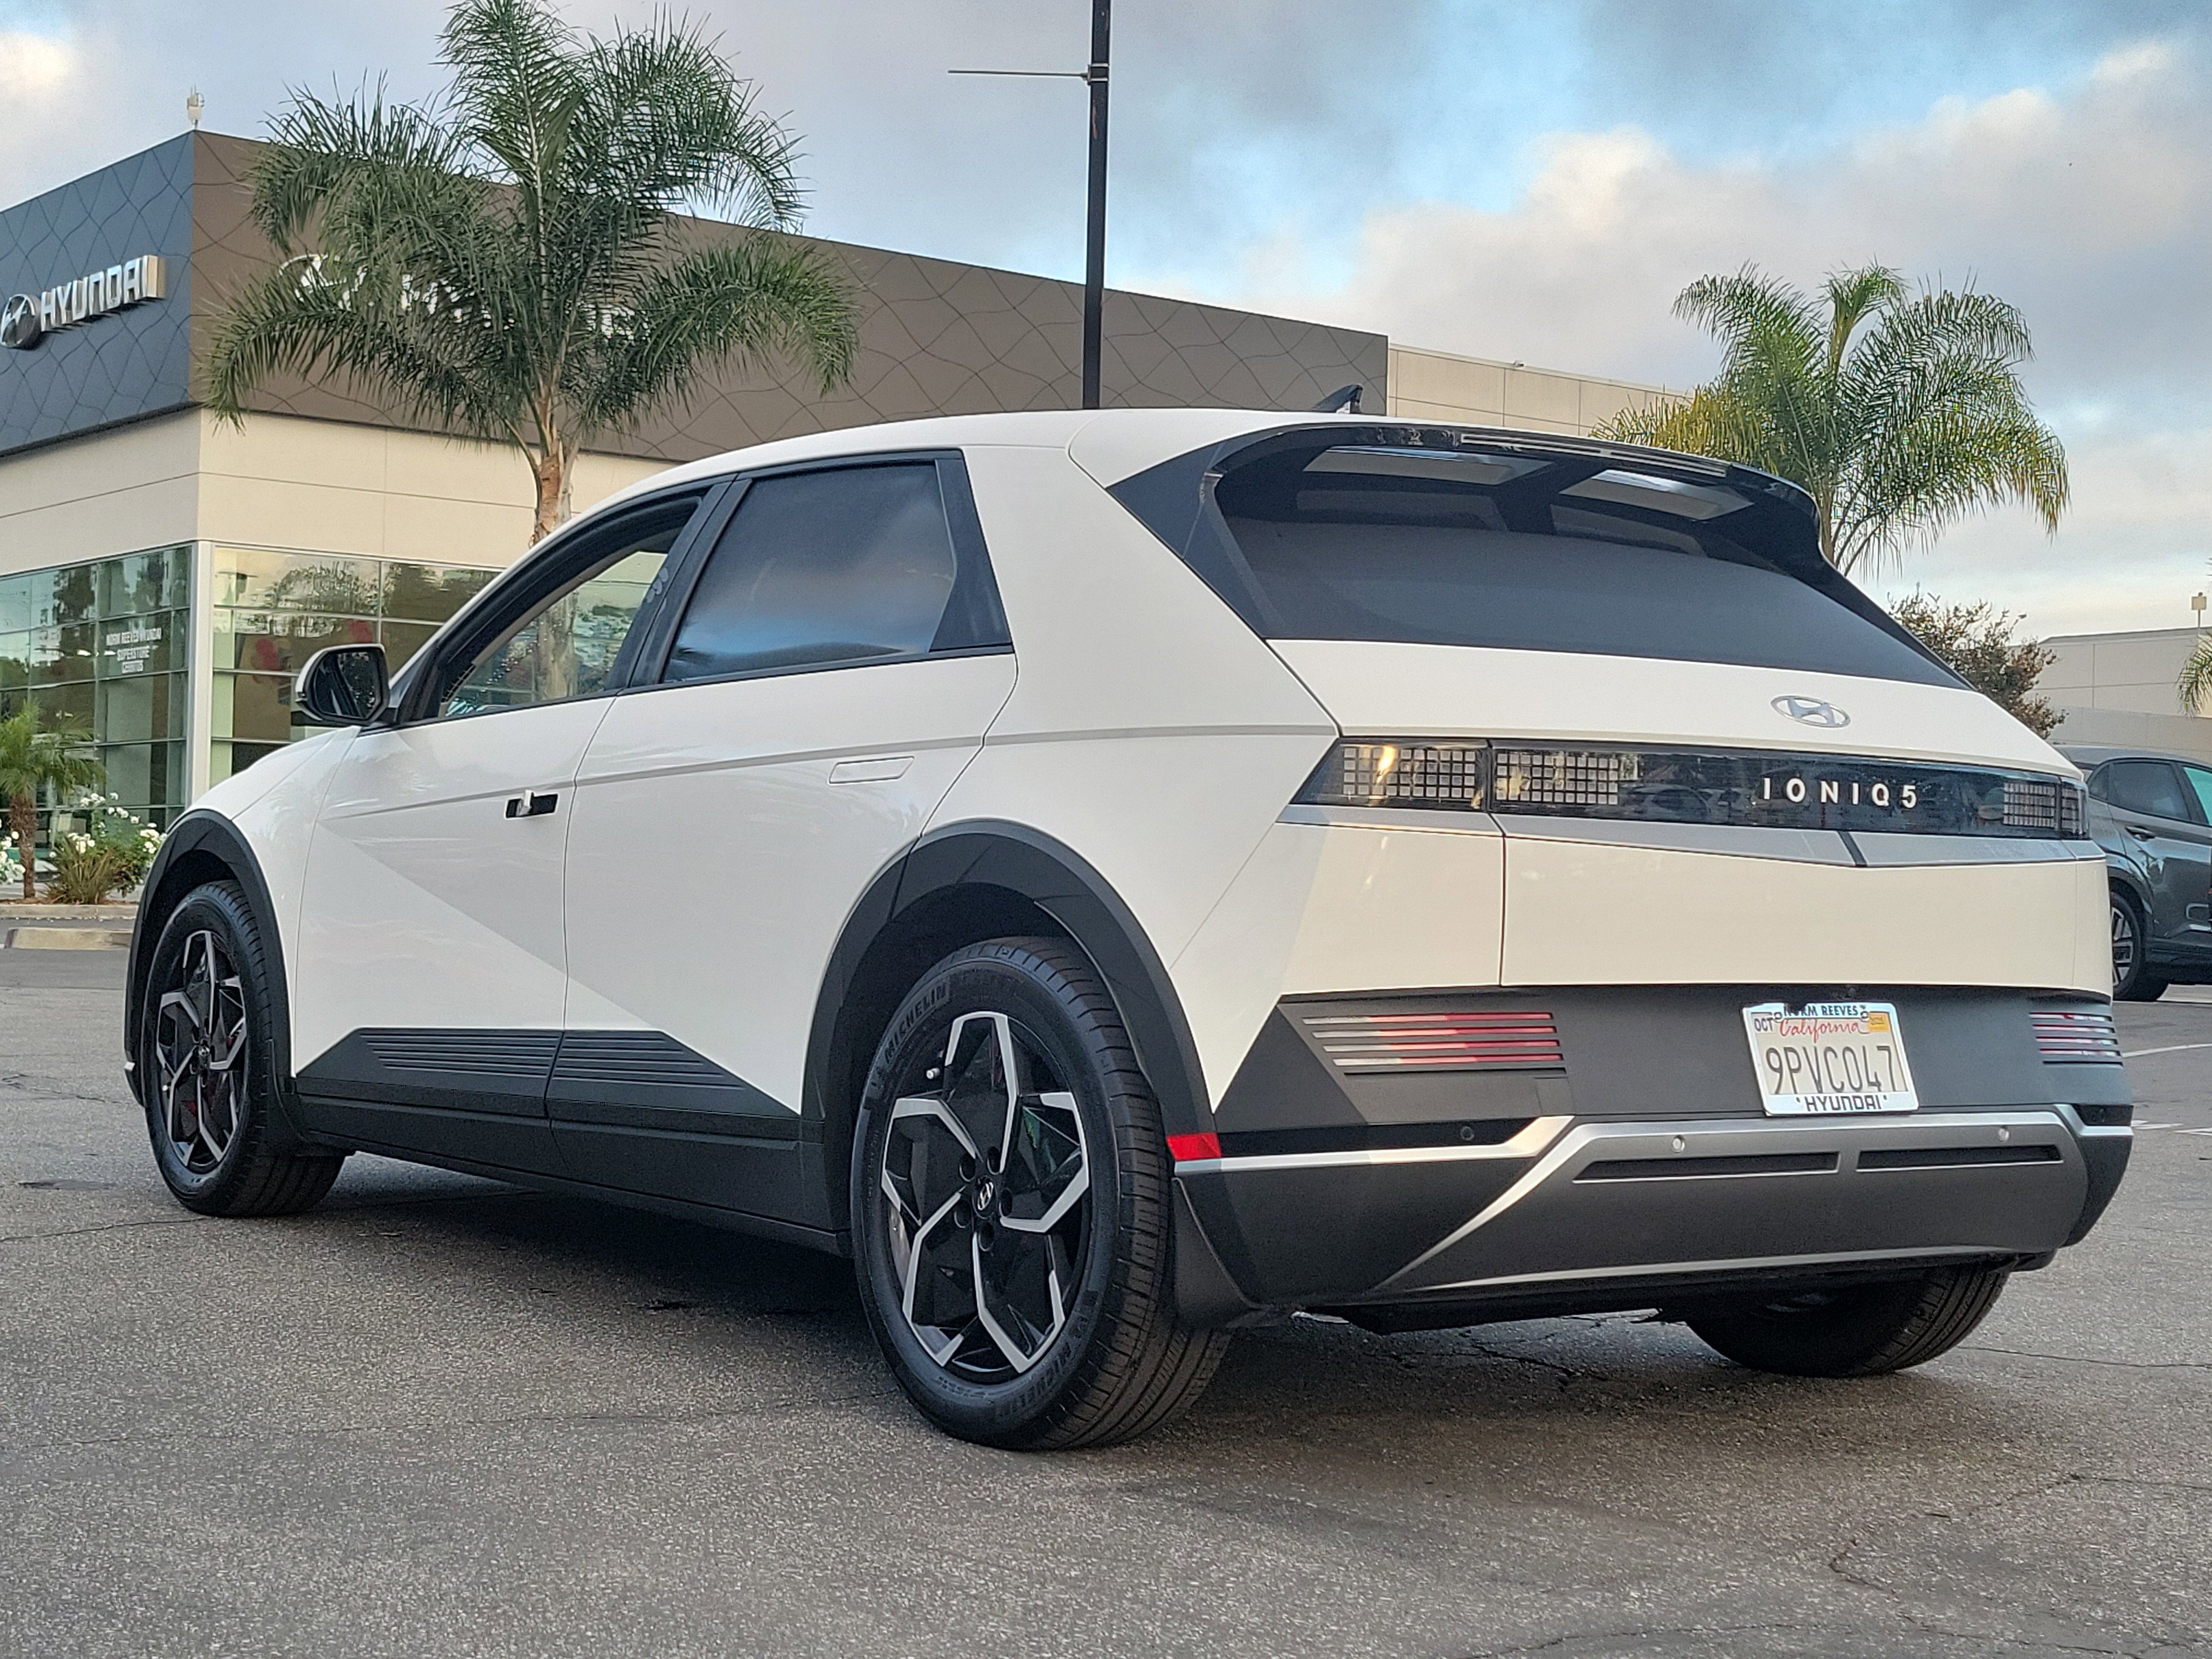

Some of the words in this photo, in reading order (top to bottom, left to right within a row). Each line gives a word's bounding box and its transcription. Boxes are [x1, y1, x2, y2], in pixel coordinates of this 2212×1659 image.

[41, 255, 158, 332] HYUNDAI
[1821, 1005, 1859, 1016] REEVES
[1754, 1017, 1774, 1032] OCT
[1780, 1018, 1870, 1043] California
[1804, 1094, 1882, 1111] HYUNDAI
